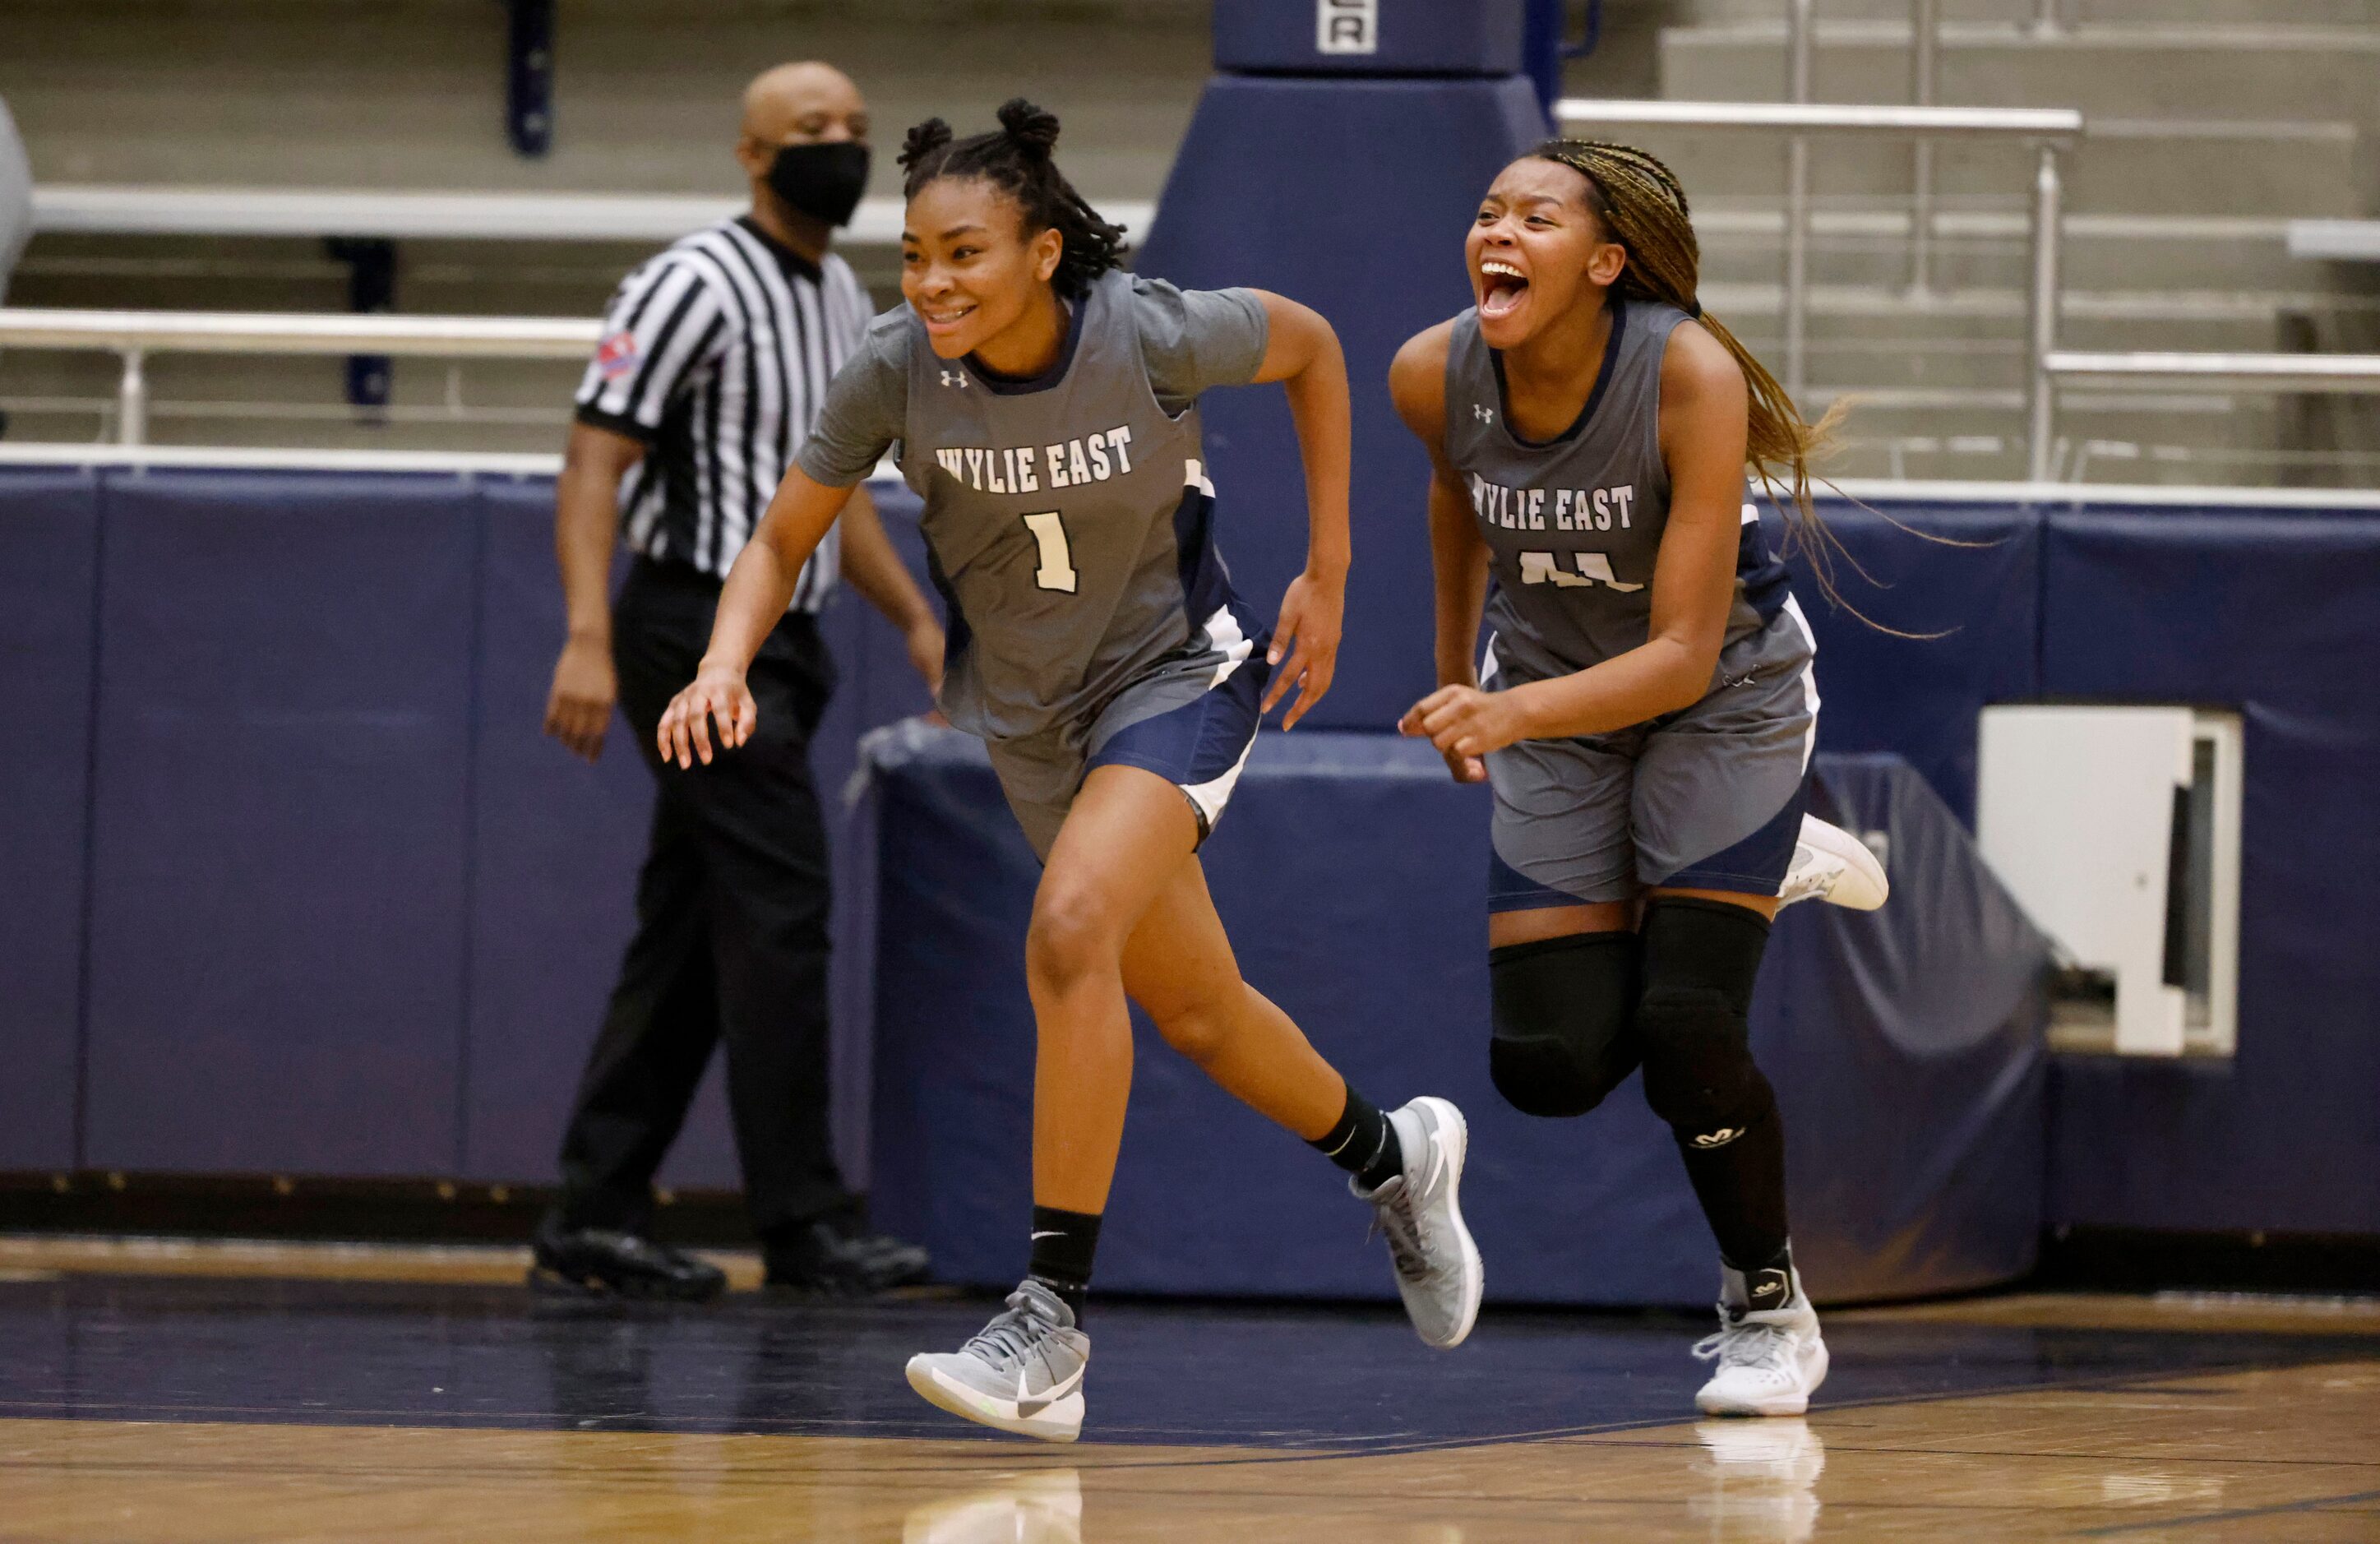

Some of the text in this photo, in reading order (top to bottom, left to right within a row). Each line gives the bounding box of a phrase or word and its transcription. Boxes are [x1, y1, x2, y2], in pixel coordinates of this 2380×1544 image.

[1045, 424, 1132, 489] EAST
[1555, 483, 1634, 532] EAST
[1022, 510, 1077, 594] 1
